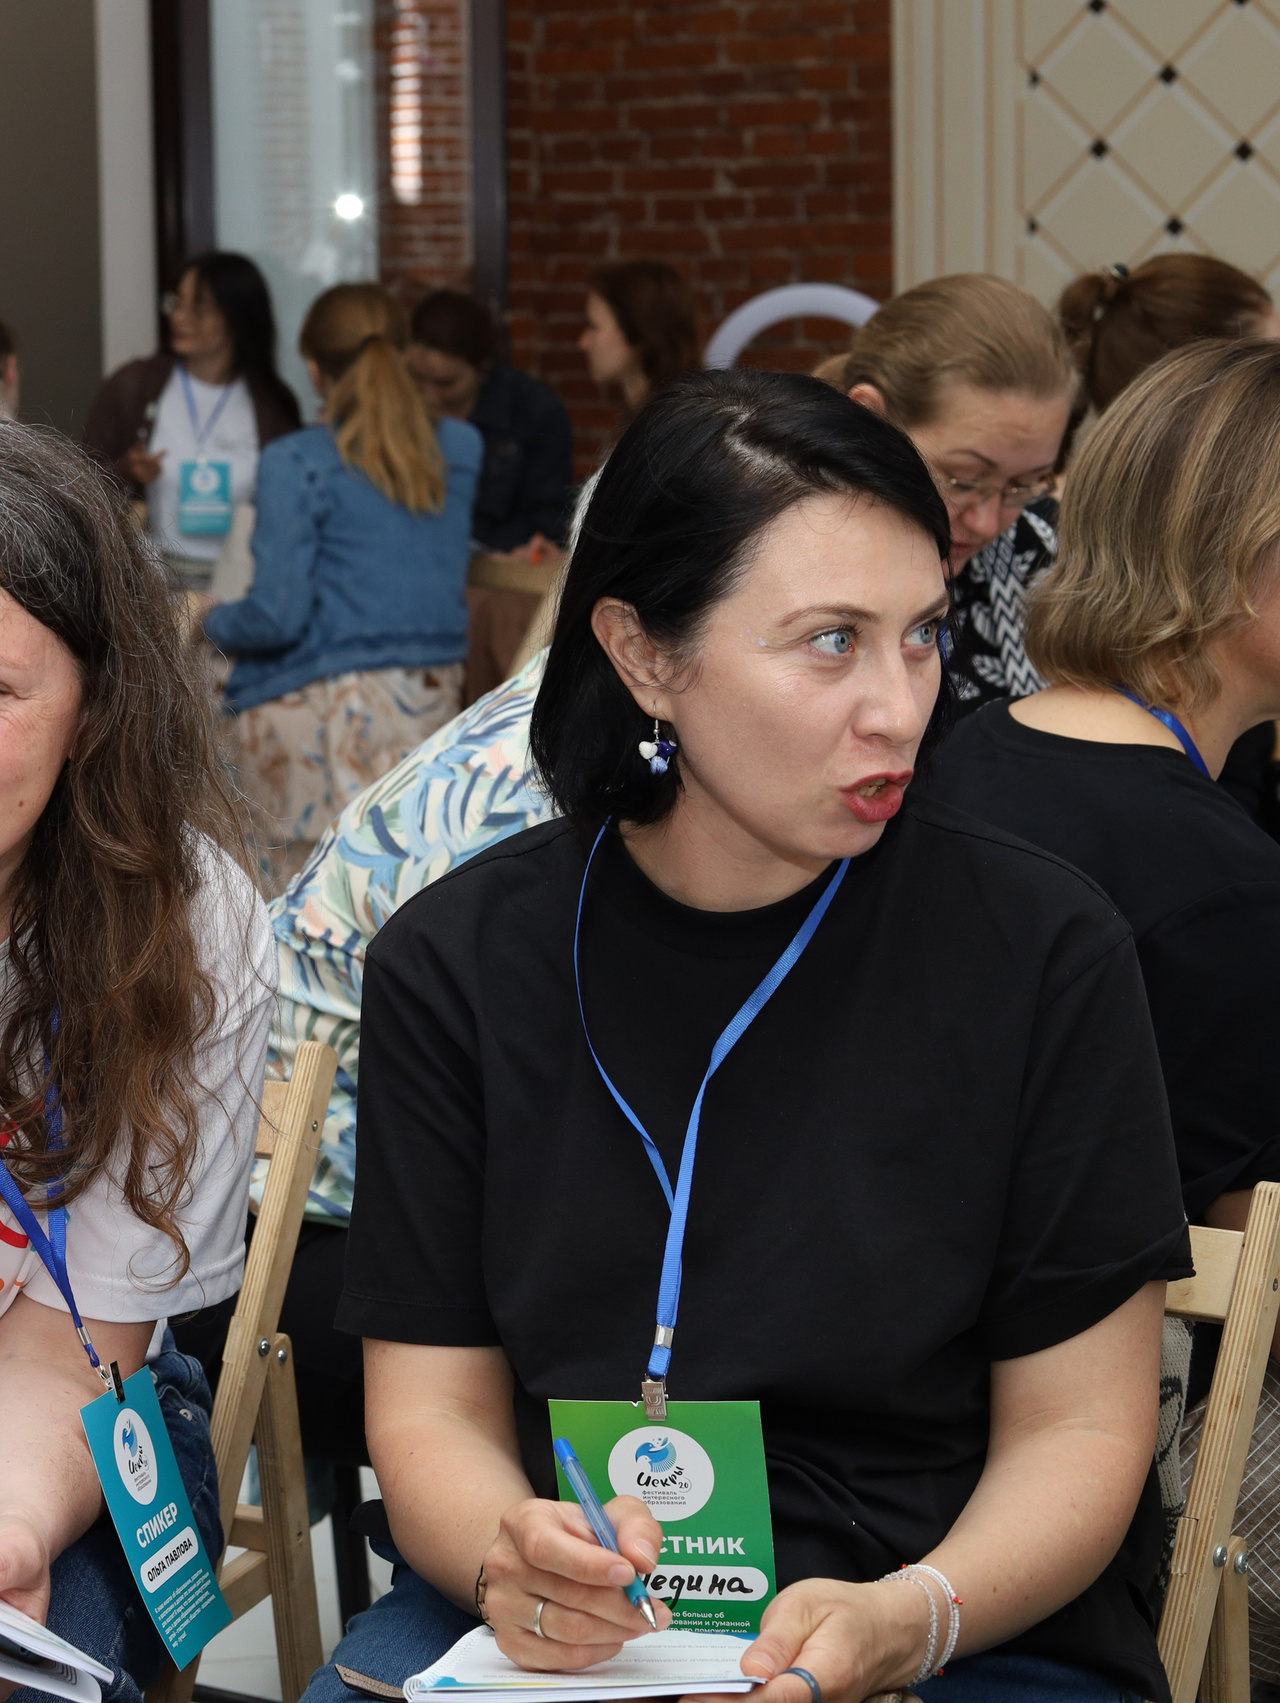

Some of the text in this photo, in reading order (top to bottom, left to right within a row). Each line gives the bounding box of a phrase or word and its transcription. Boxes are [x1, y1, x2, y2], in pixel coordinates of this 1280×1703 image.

[136, 1502, 178, 1549] СПИКЕР
[147, 1537, 194, 1582] ОЛЬГА ПАВЛОВА
[643, 1572, 754, 1611] едина
[681, 1610, 713, 1619] больше
[714, 1611, 725, 1619] об
[711, 1619, 751, 1628] гуманной
